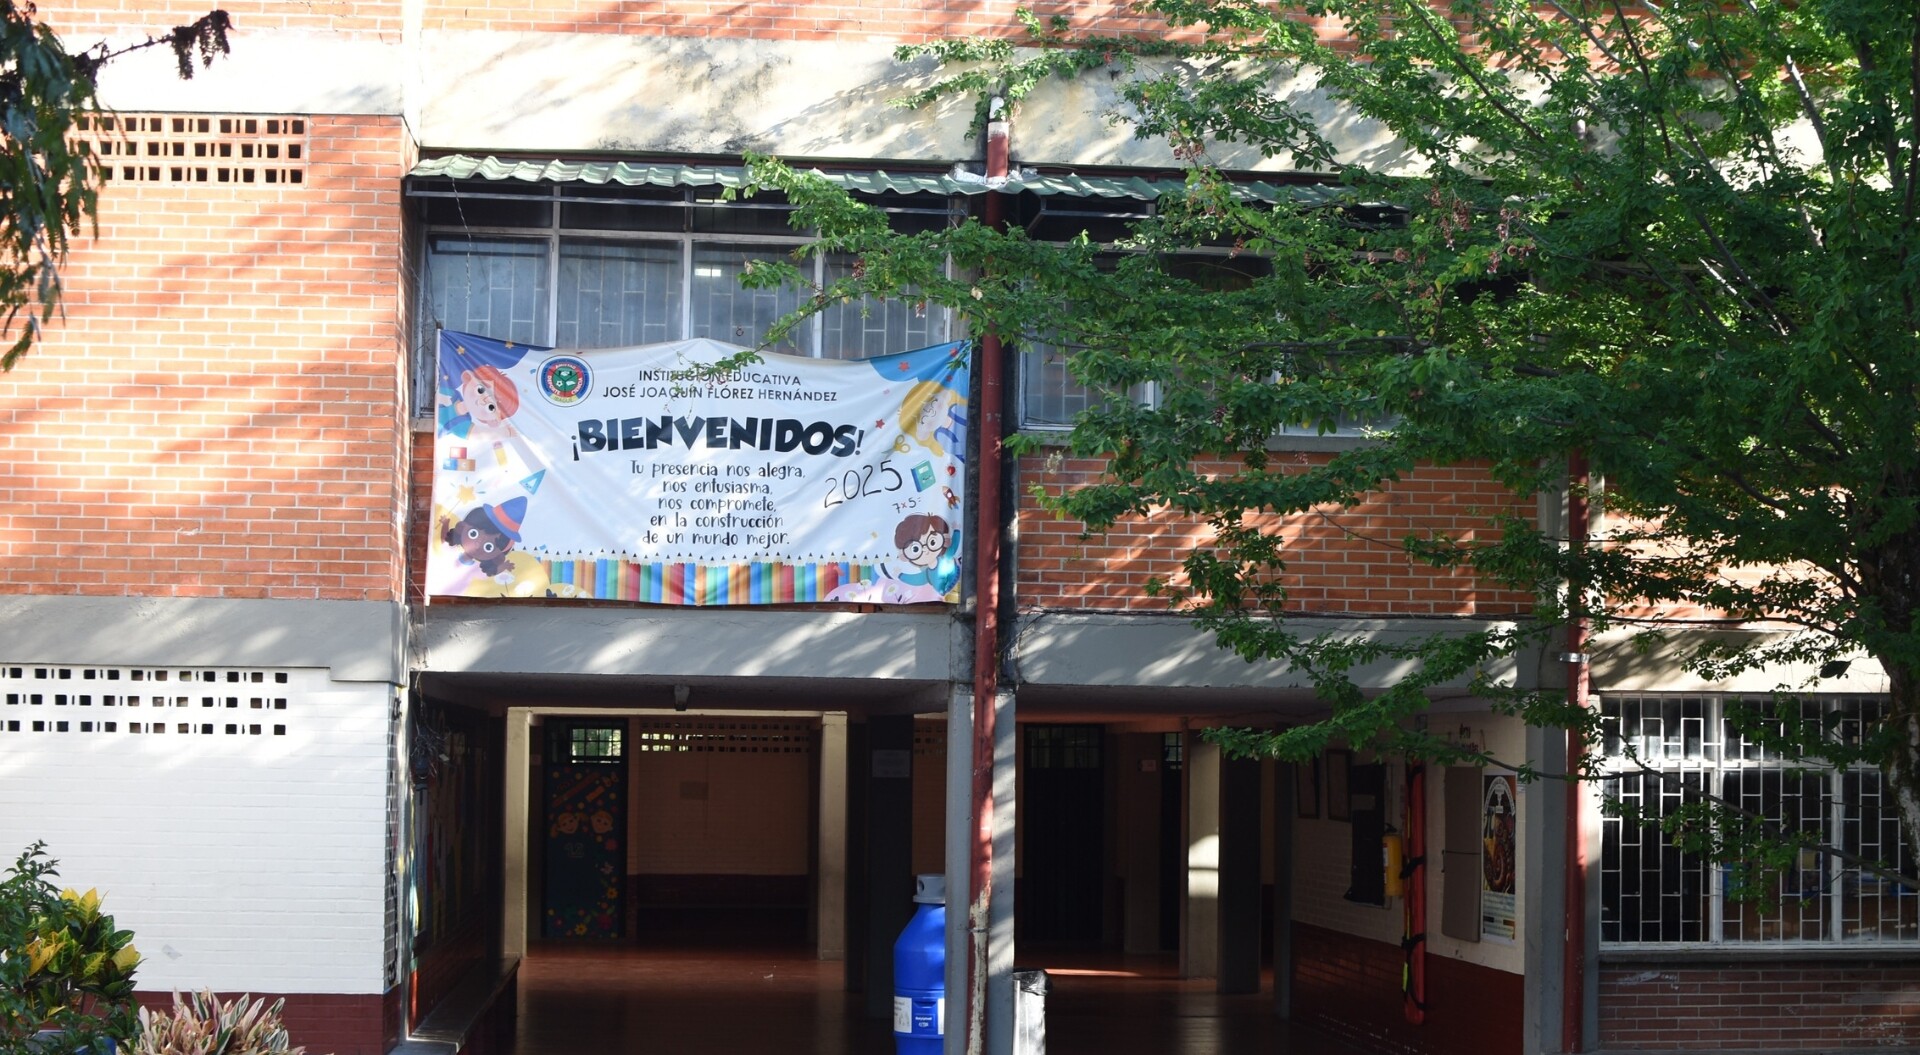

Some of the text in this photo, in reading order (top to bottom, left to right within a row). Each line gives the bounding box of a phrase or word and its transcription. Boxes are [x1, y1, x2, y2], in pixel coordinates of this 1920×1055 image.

[727, 371, 801, 386] EDUCATIVA
[603, 384, 837, 401] JOSÉ JOAQUÍN FLÓREZ HERNÁNDEZ
[571, 415, 864, 461] ¡BIENVENIDOS!
[631, 460, 806, 480] Tu presencia nos alegra,
[662, 478, 773, 495] nos entusiasma,
[824, 460, 902, 508] 2025
[658, 496, 777, 513] nos compromete,
[650, 512, 784, 528] en la construcción
[642, 530, 790, 549] de un mundo mejor.
